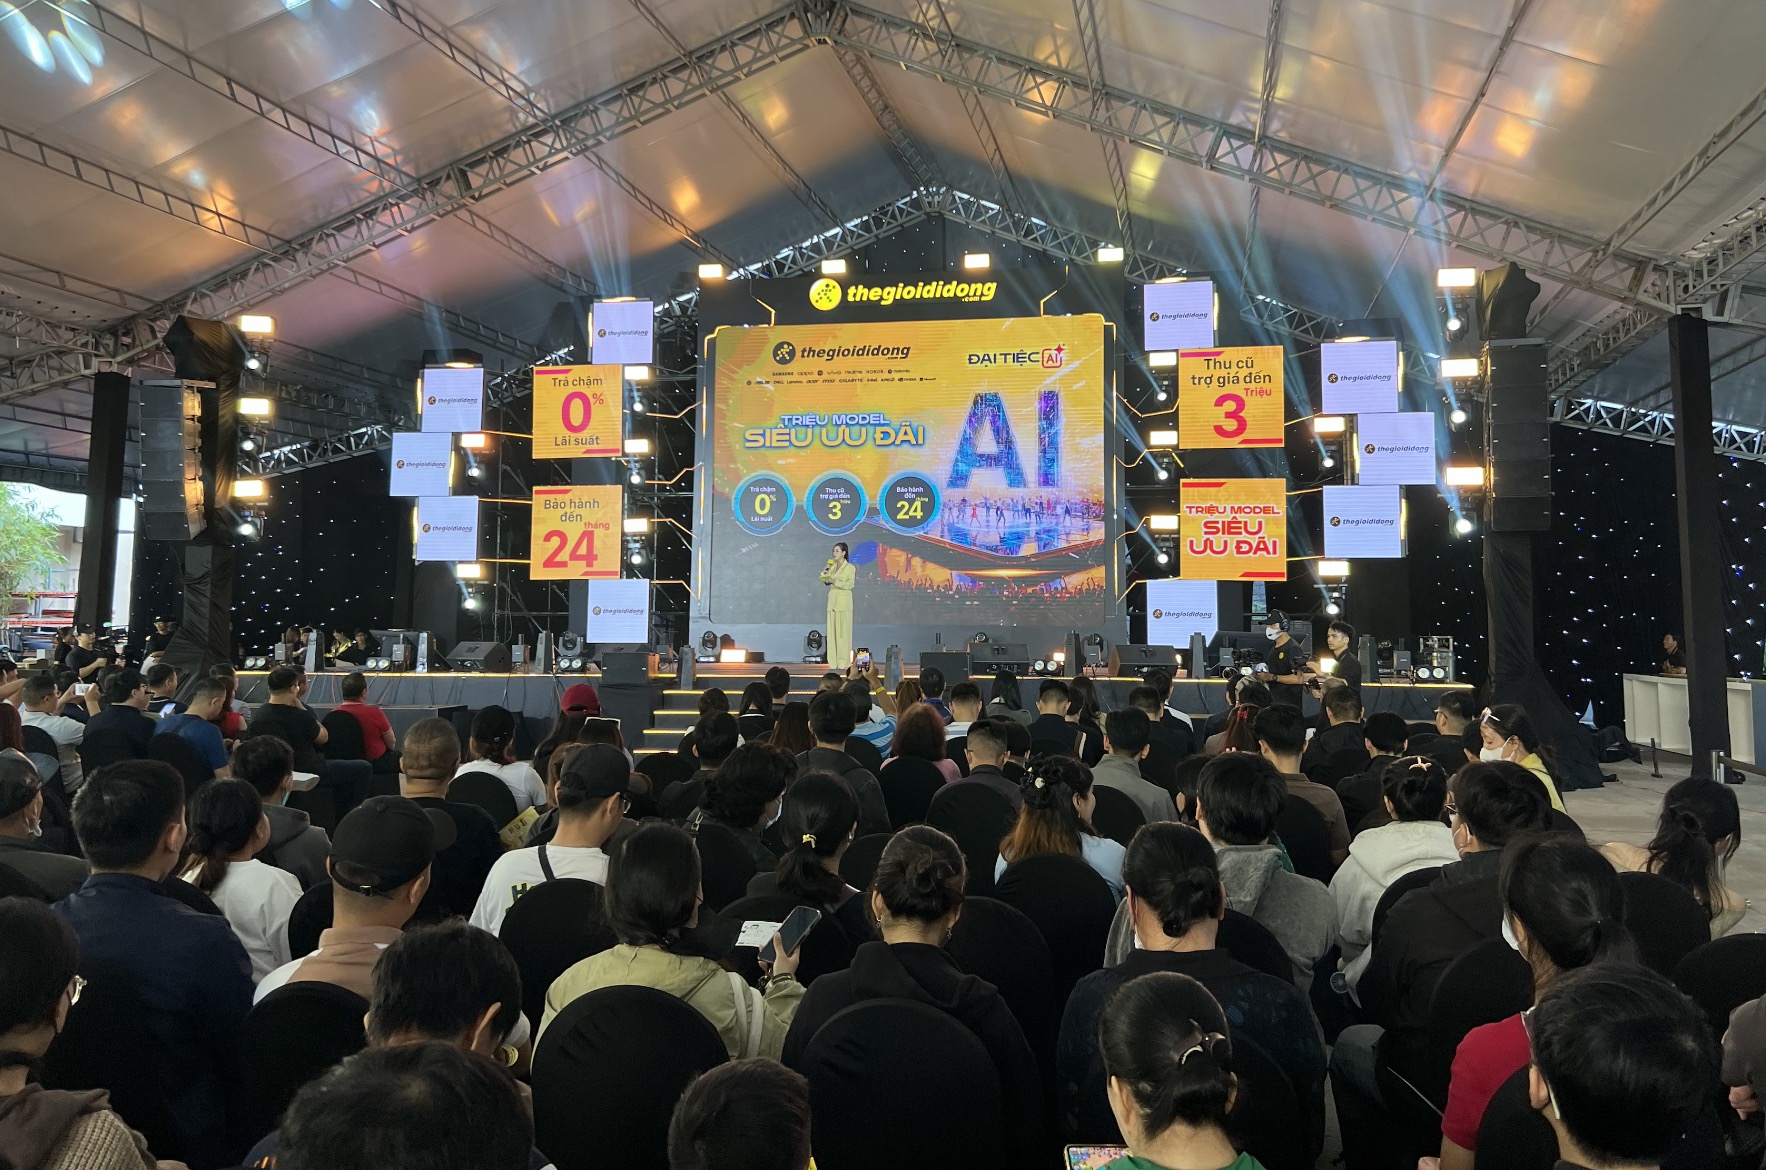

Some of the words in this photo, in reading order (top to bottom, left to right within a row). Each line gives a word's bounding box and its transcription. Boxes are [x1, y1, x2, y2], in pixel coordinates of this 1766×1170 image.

[847, 280, 997, 305] thegioididong
[1161, 312, 1208, 320] thegioididong
[800, 345, 911, 362] thegioididong
[968, 353, 997, 368] ĐẠI
[999, 349, 1040, 366] TIỆC
[1046, 353, 1058, 364] AI
[1203, 358, 1232, 370] Thu
[1236, 356, 1254, 369] cũ
[552, 376, 569, 387] Trả
[572, 376, 603, 388] chậm
[1190, 373, 1214, 388] trợ
[1217, 370, 1240, 388] giá
[1243, 370, 1272, 384] đến
[1340, 374, 1392, 382] thegioididong
[780, 412, 828, 427] TRIỆU
[832, 413, 890, 425] MODEL
[1212, 393, 1248, 438] 3
[1244, 387, 1272, 398] Triệu
[554, 436, 572, 446] Lãi
[574, 434, 600, 446] suất
[744, 424, 813, 448] SIÊU
[820, 425, 868, 448] ƯU
[874, 422, 925, 446] ĐÃI
[946, 390, 1061, 489] AI
[544, 498, 566, 510] Bảo
[569, 498, 600, 509] hành
[828, 501, 842, 520] 3
[896, 501, 923, 519] 24
[1184, 503, 1228, 517] TRIỆU
[1230, 506, 1281, 515] MODEL
[560, 510, 583, 522] đến
[1342, 517, 1394, 526] thegioididong
[1202, 516, 1264, 536] SIÊU
[542, 529, 598, 568] 24
[584, 522, 610, 531] tháng
[1188, 537, 1229, 555] ƯU
[1234, 536, 1278, 556] ĐÃI
[1164, 610, 1212, 618] thegioididong
